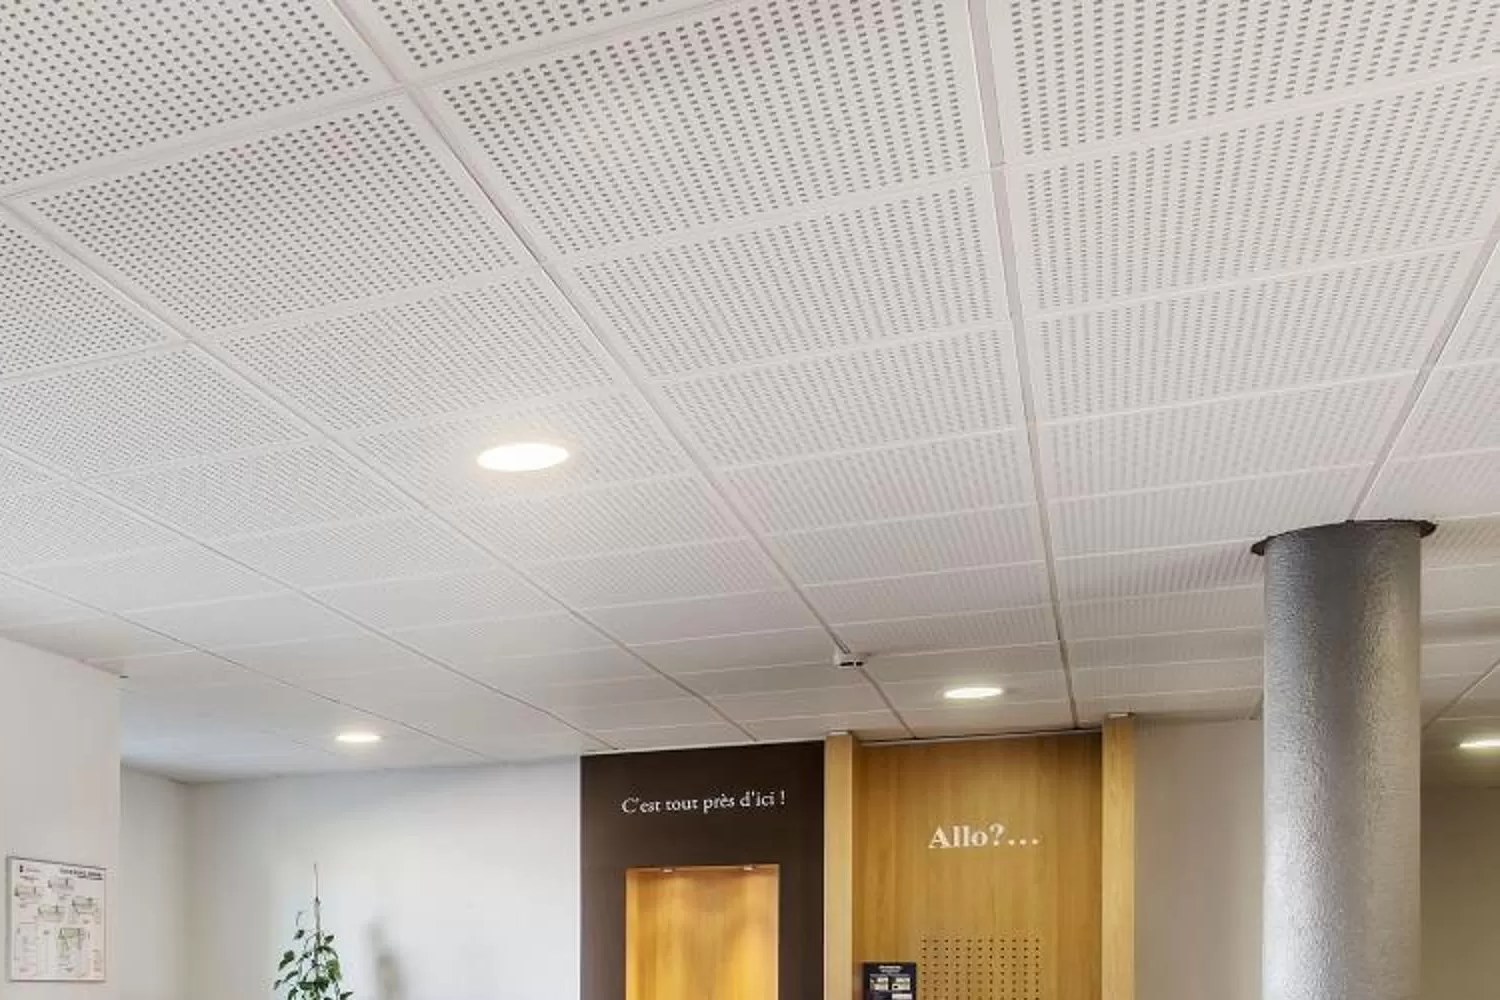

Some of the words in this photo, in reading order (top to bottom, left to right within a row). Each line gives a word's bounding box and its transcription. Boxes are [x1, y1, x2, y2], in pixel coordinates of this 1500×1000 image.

[621, 797, 661, 813] C'est
[665, 799, 698, 812] tout
[703, 793, 735, 814] près
[739, 791, 775, 807] d'ici
